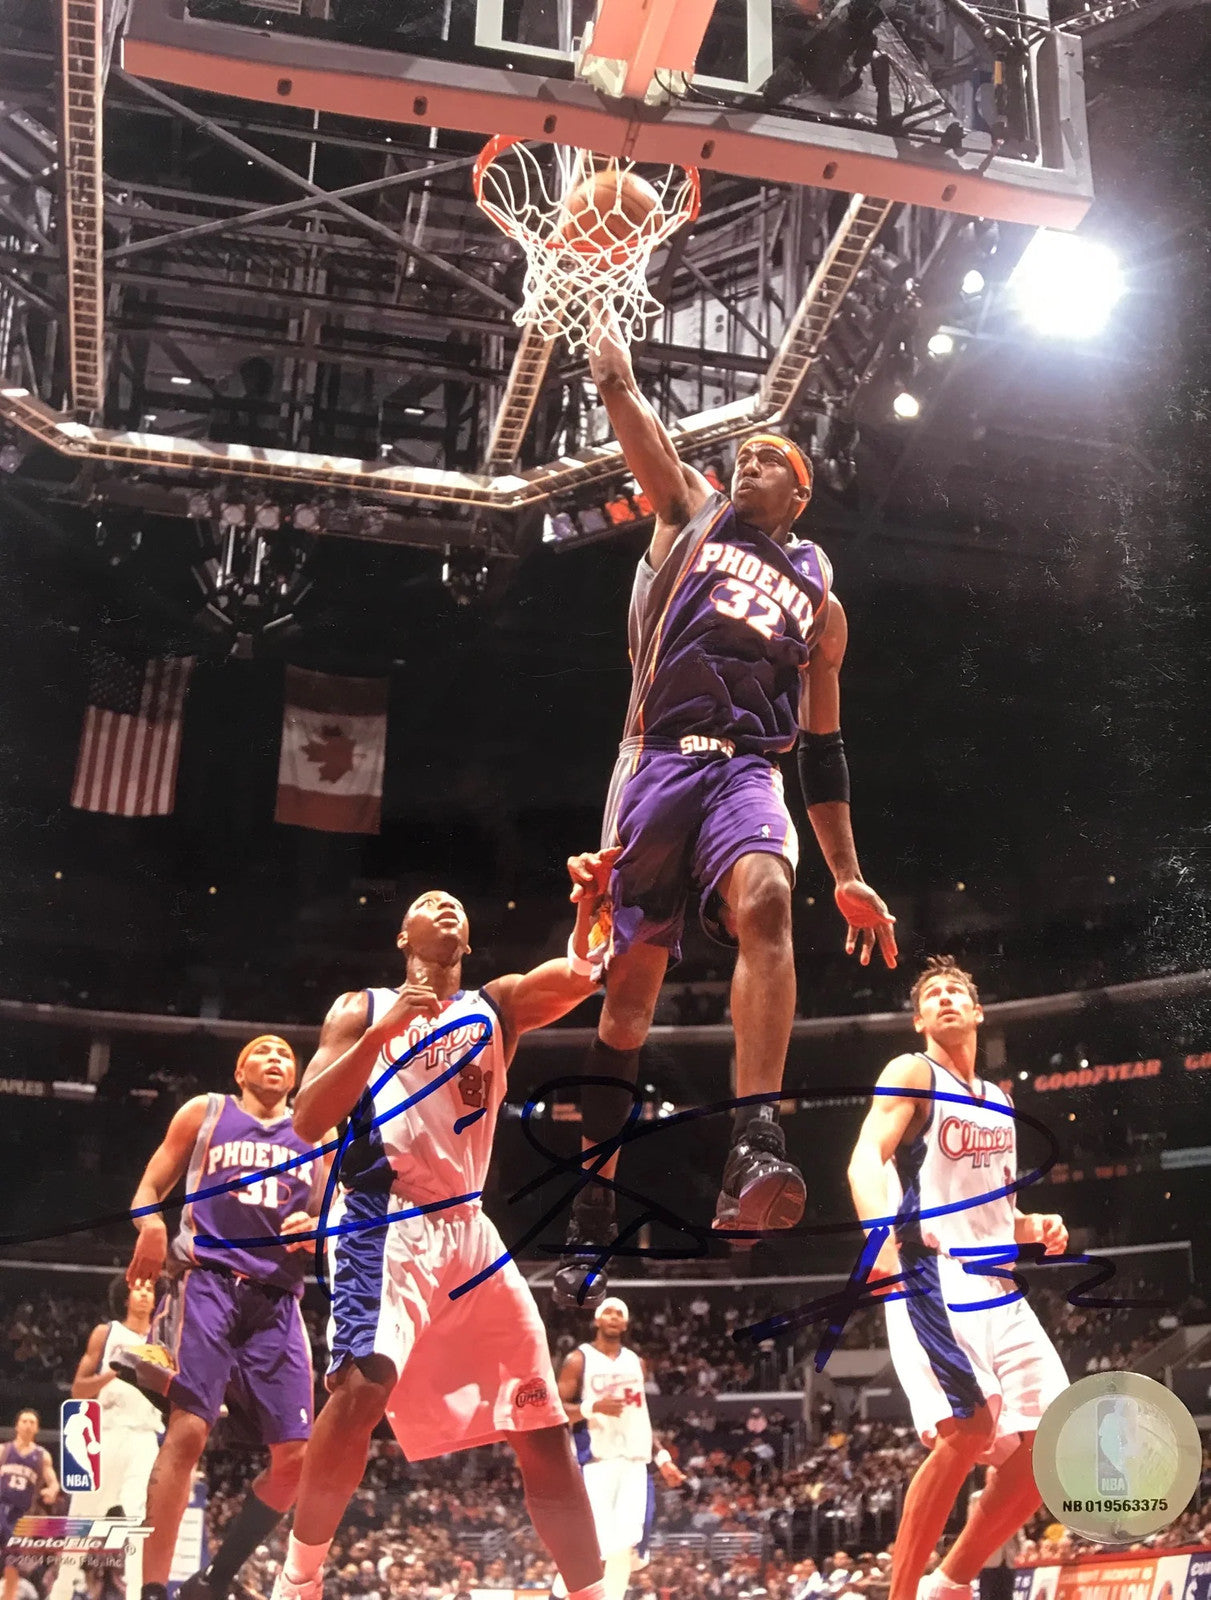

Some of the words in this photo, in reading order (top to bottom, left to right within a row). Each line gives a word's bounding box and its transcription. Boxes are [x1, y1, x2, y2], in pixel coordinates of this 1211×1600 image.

[693, 543, 814, 639] PHOENIX
[714, 578, 782, 640] 32
[1034, 1059, 1162, 1092] GOODYEAR
[207, 1140, 313, 1186] PHOENIX
[238, 1172, 278, 1209] 31
[1101, 1477, 1125, 1491] NBA
[1063, 1500, 1083, 1512] NB
[1085, 1499, 1169, 1512] 019563375
